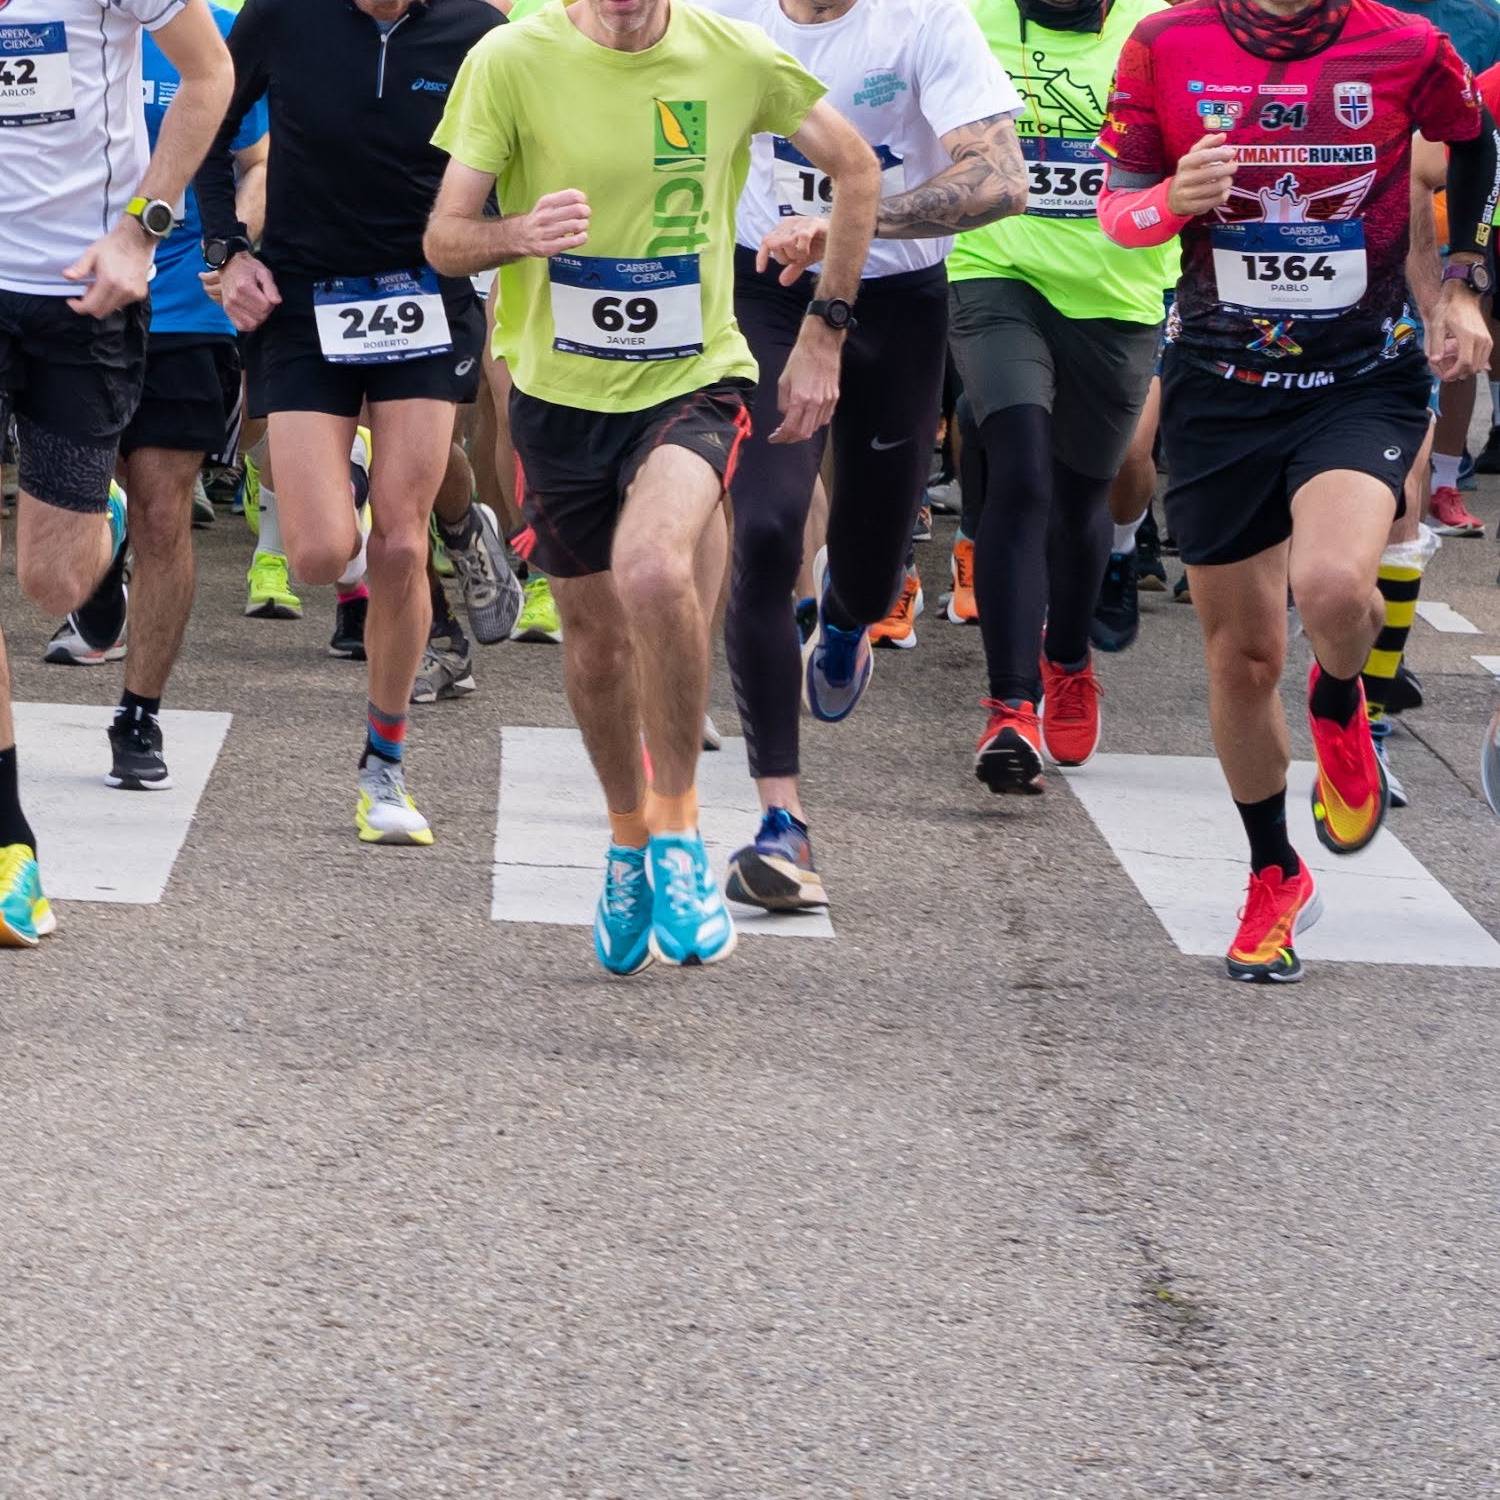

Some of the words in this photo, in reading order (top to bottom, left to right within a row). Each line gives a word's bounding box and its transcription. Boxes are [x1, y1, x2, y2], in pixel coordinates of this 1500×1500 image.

[2, 40, 45, 50] CIENCIA
[423, 81, 448, 92] asics
[1261, 102, 1309, 131] 34
[1028, 163, 1105, 196] 336
[1039, 198, 1062, 206] JOSÉ
[1064, 198, 1094, 206] MARÍA
[1279, 225, 1327, 236] CARRERA
[1295, 235, 1340, 247] CIENCIA
[616, 261, 664, 273] CARRERA
[1241, 255, 1337, 282] 1364
[632, 270, 677, 284] CIENCIA
[1270, 284, 1309, 292] PABLO
[338, 301, 425, 340] 249
[592, 296, 658, 334] 69
[363, 338, 410, 350] ROBERTO
[606, 335, 646, 346] JAVIER
